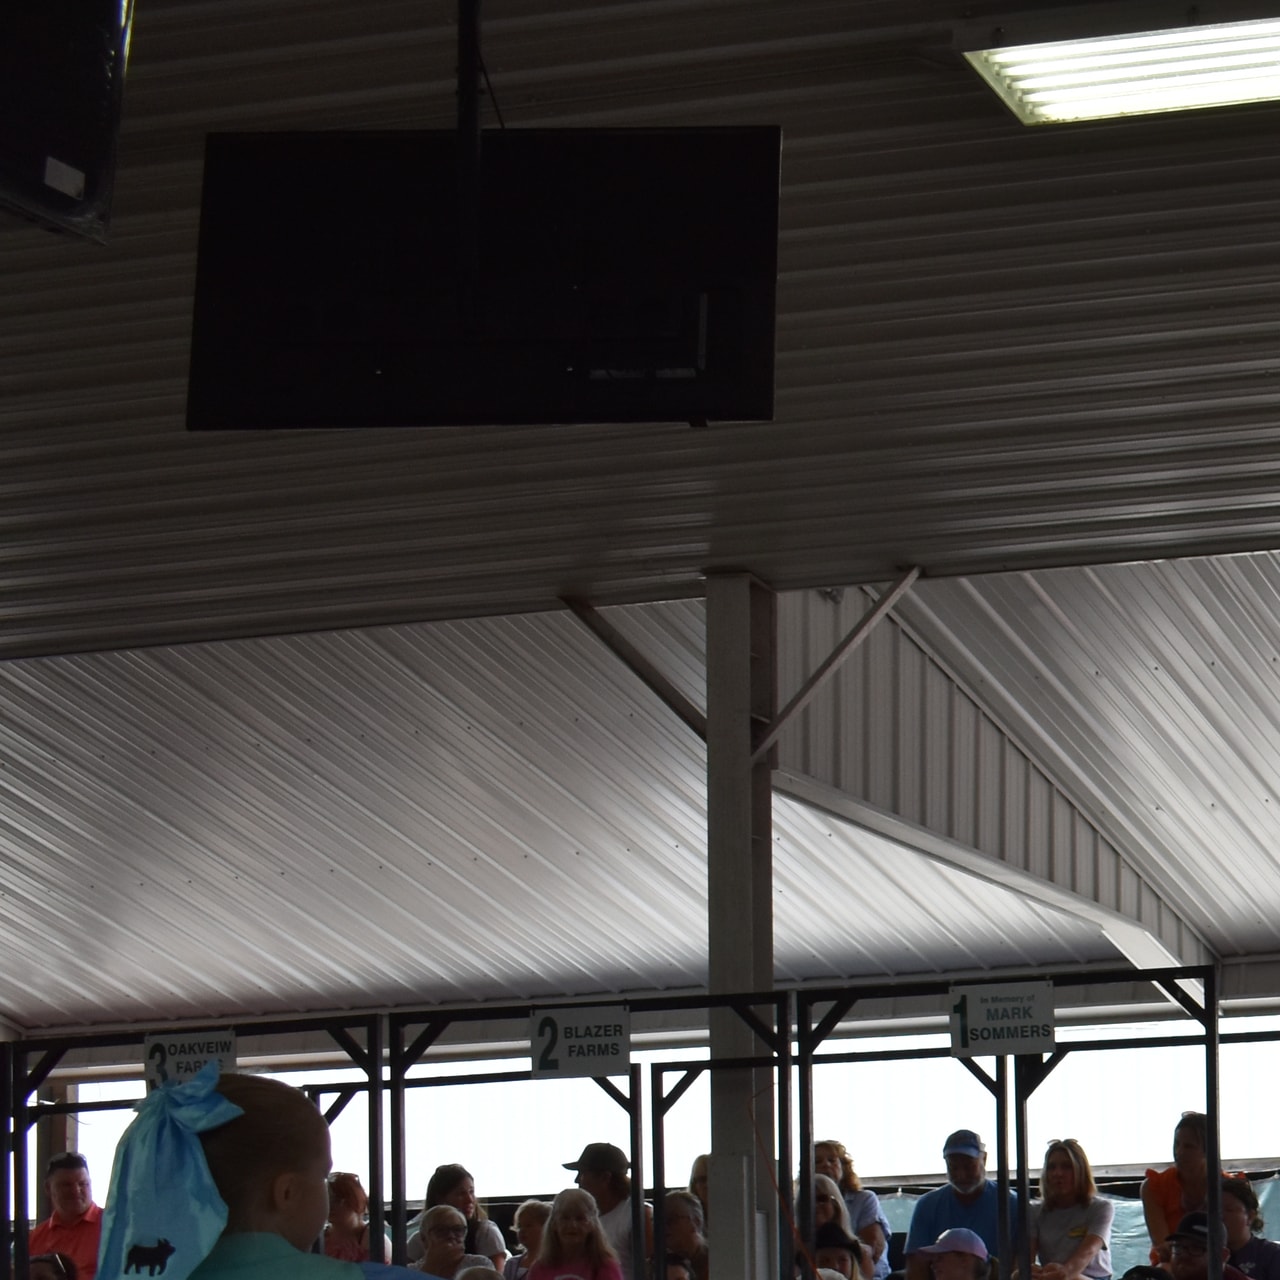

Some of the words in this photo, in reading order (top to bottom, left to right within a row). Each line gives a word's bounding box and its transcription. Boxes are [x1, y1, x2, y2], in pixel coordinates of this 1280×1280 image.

[990, 995, 1025, 1004] Memory
[1026, 994, 1035, 1002] of
[953, 994, 969, 1048] 1
[986, 1006, 1033, 1021] MARK
[563, 1024, 623, 1039] BLAZER
[969, 1024, 1051, 1041] SOMMERS
[168, 1041, 232, 1056] OAKVEIW
[538, 1016, 559, 1070] 2
[567, 1043, 620, 1057] FARMS
[148, 1042, 169, 1089] 3
[176, 1058, 224, 1073] FARS
